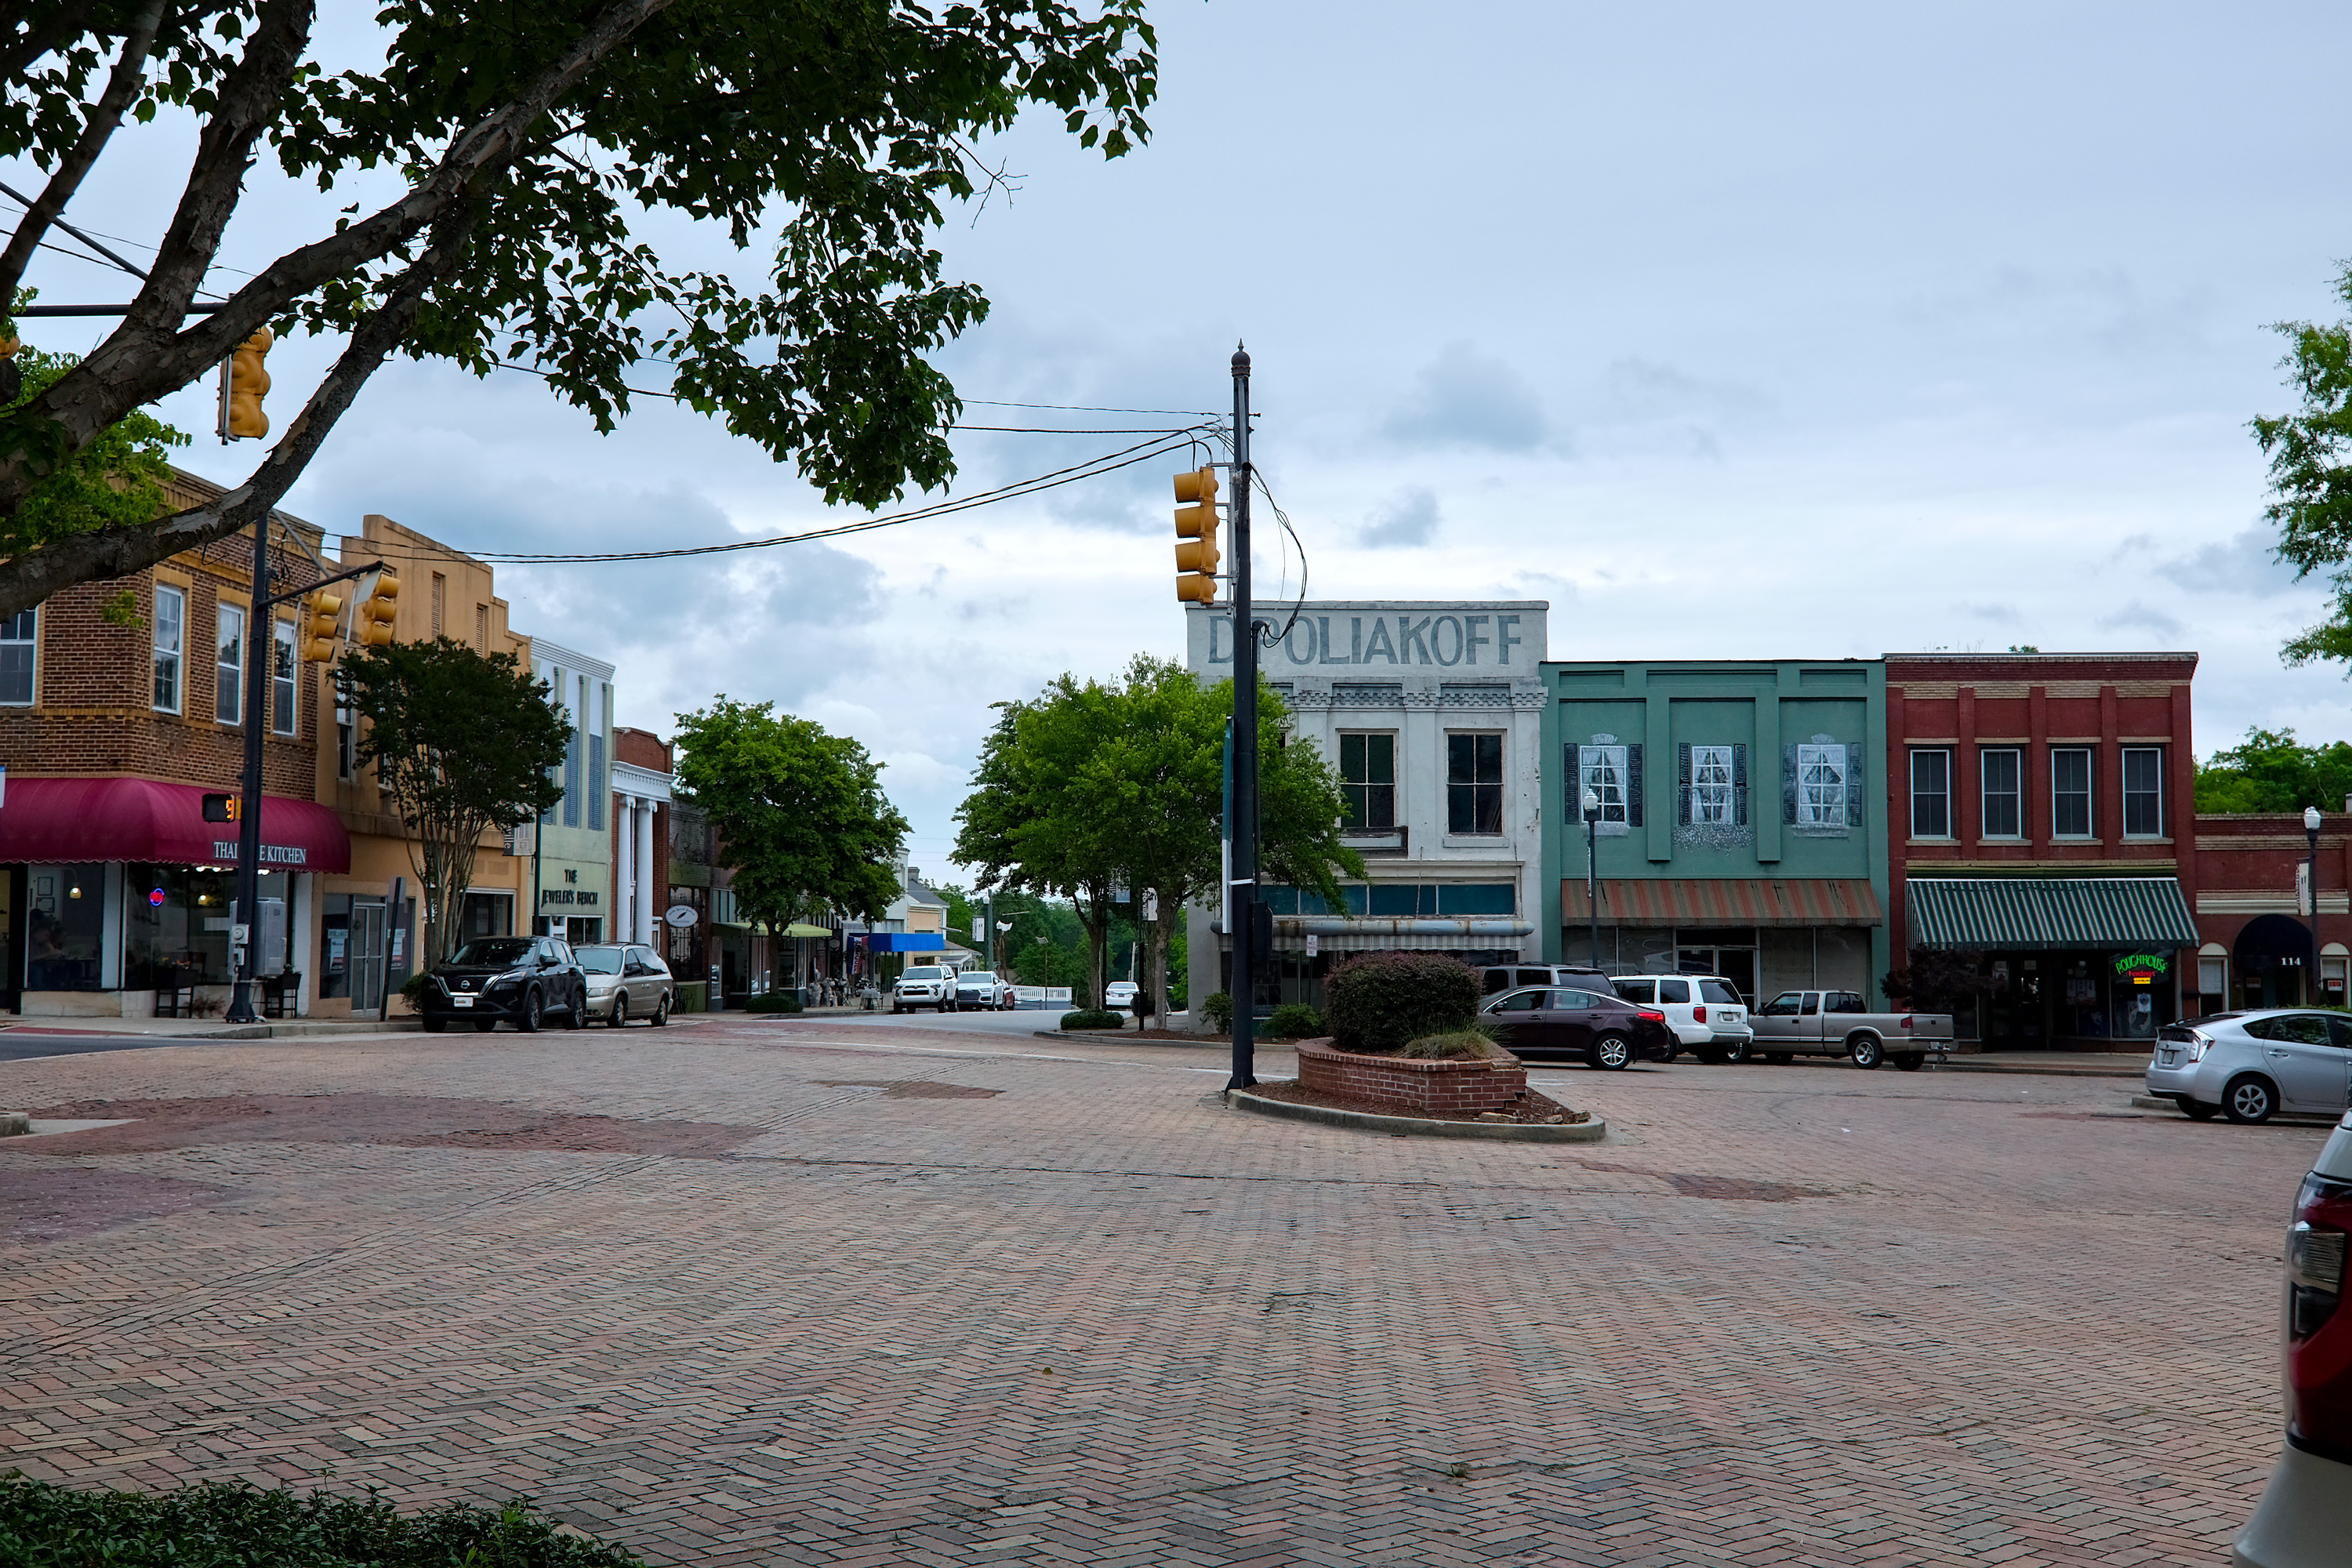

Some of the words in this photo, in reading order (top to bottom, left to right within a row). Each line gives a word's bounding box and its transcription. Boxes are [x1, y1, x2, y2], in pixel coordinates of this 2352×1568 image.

[1252, 615, 1521, 666] POLIAKOFF
[267, 846, 307, 864] KITCHEN
[564, 869, 578, 884] THE
[541, 889, 575, 907] JEWELER'S
[577, 891, 598, 906] BENCH
[2281, 957, 2301, 966] 114
